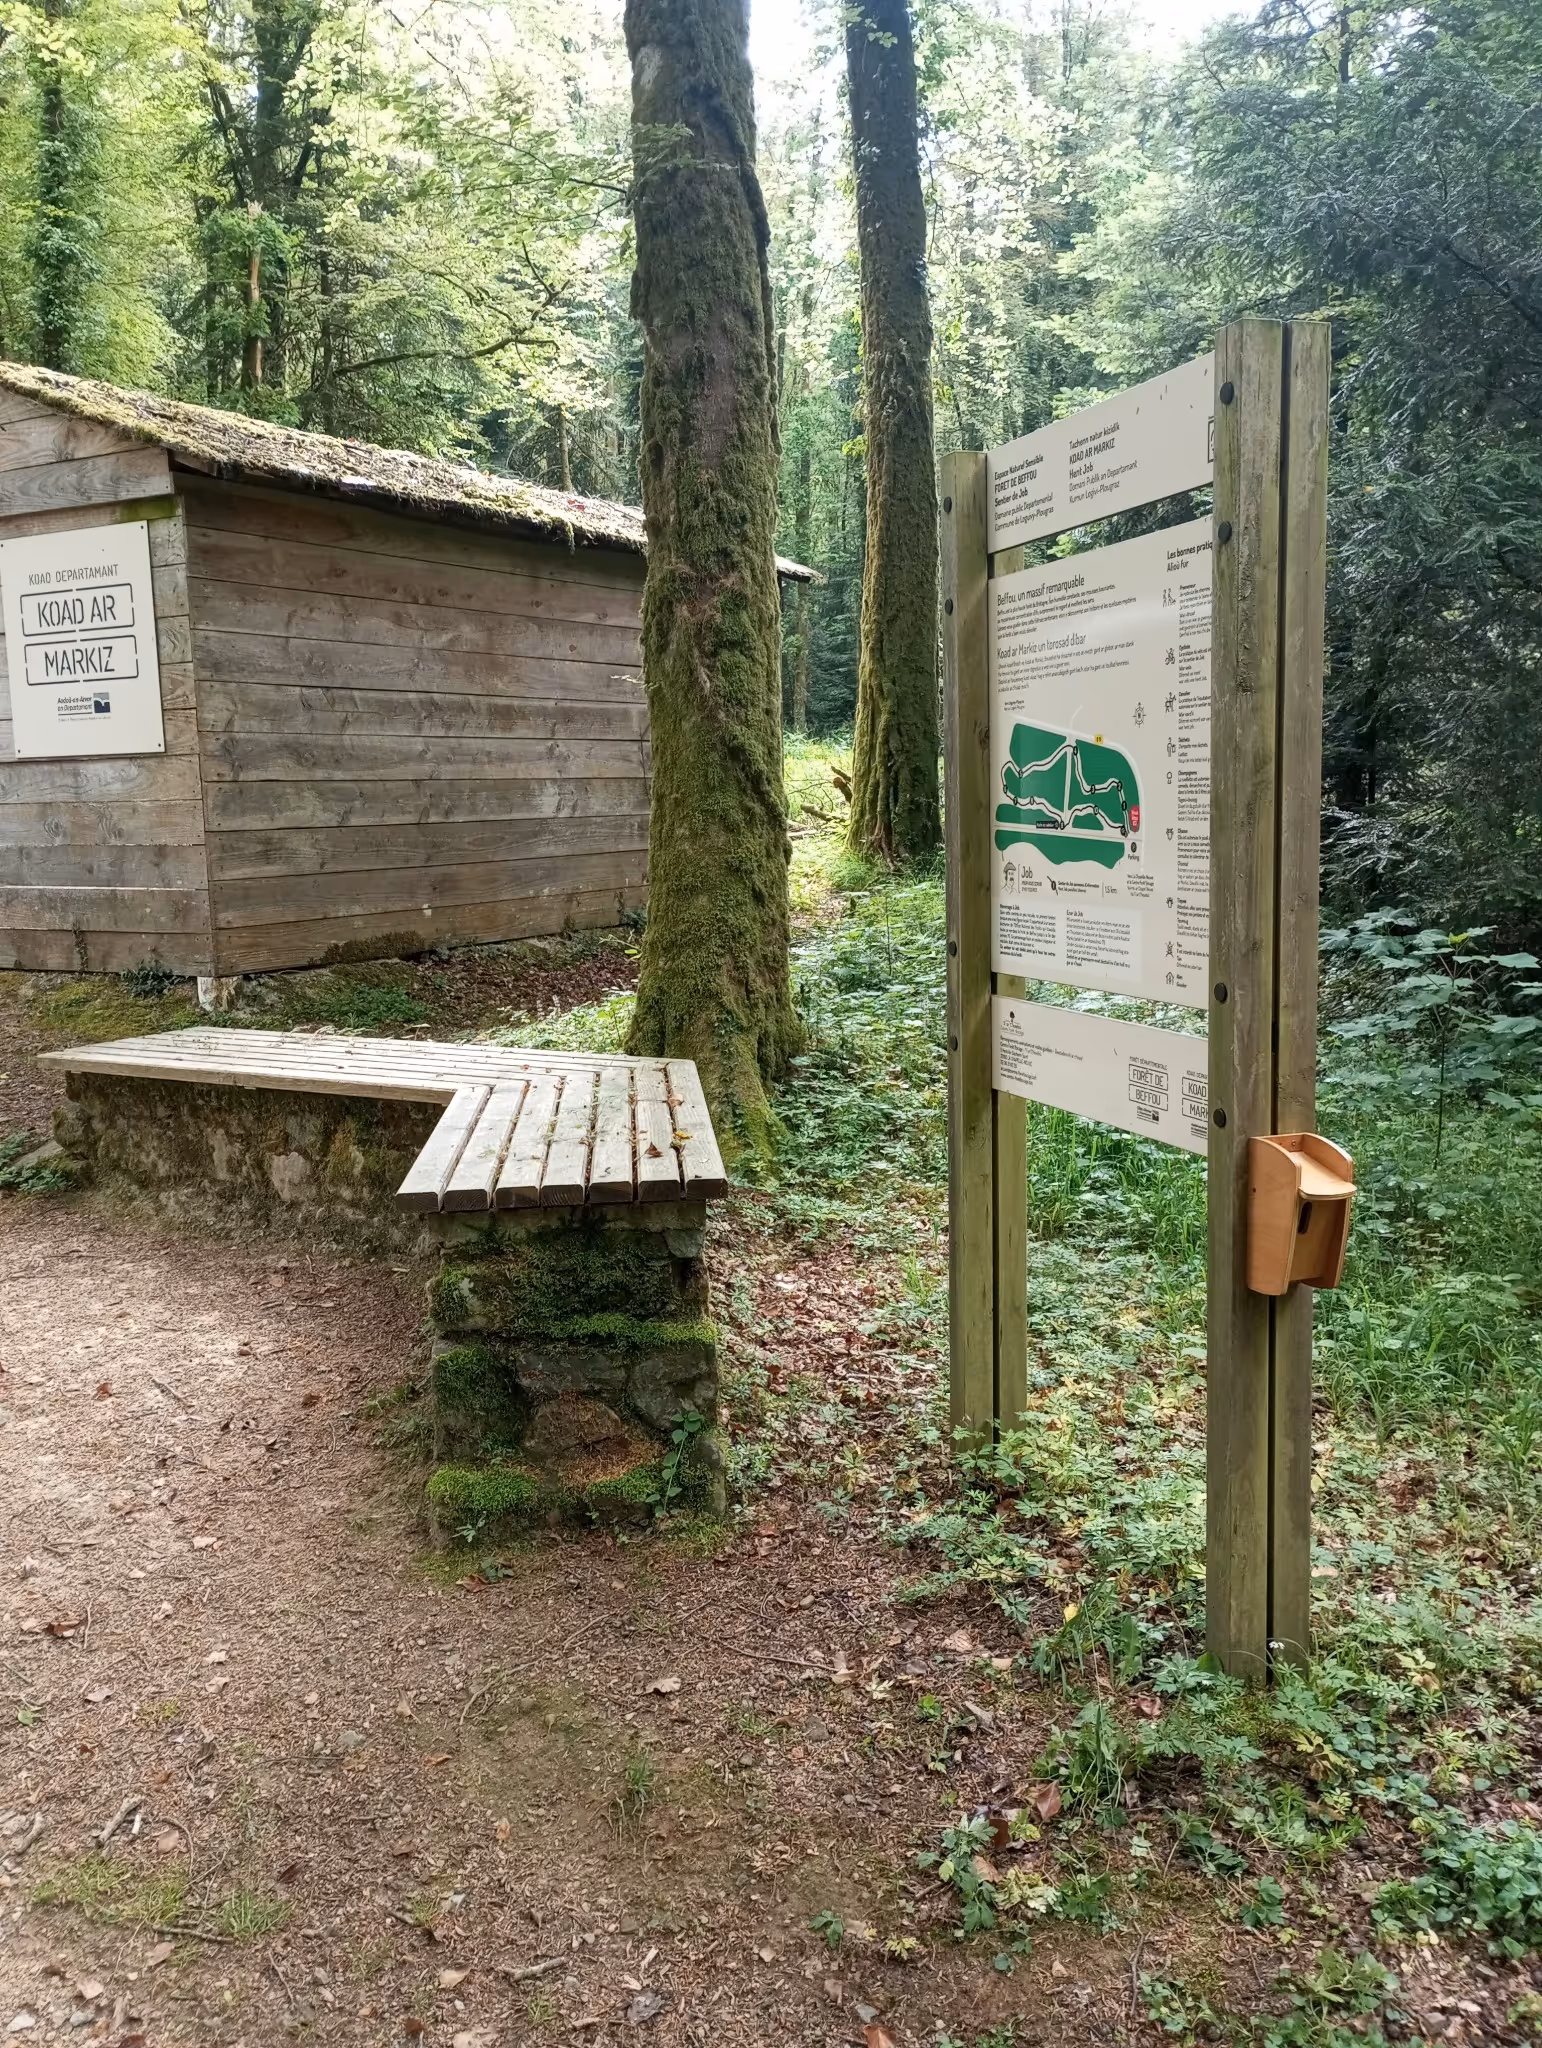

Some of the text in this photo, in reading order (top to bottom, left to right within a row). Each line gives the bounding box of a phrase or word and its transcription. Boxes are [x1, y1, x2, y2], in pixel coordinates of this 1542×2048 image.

[1085, 447, 1093, 459] AR
[1093, 437, 1116, 455] MARKIZ
[1069, 461, 1094, 480] Hent Job
[995, 486, 1029, 508] Sentier de Job
[1167, 540, 1213, 560] Les bonnes pratiq
[55, 564, 119, 583] DEPARTAMANT
[1017, 591, 1026, 602] un
[1025, 582, 1046, 599] massif
[1045, 574, 1085, 596] remarquable
[37, 595, 117, 628] KOAD AR
[997, 645, 1011, 659] Koad
[1011, 647, 1018, 657] ar
[1038, 643, 1046, 652] un
[44, 646, 115, 677] MARKIZ
[1021, 865, 1034, 879] Job
[1132, 1068, 1164, 1087] FORÊT DE
[1135, 1089, 1161, 1106] BEFFOU
[1188, 1082, 1207, 1098] KOAD
